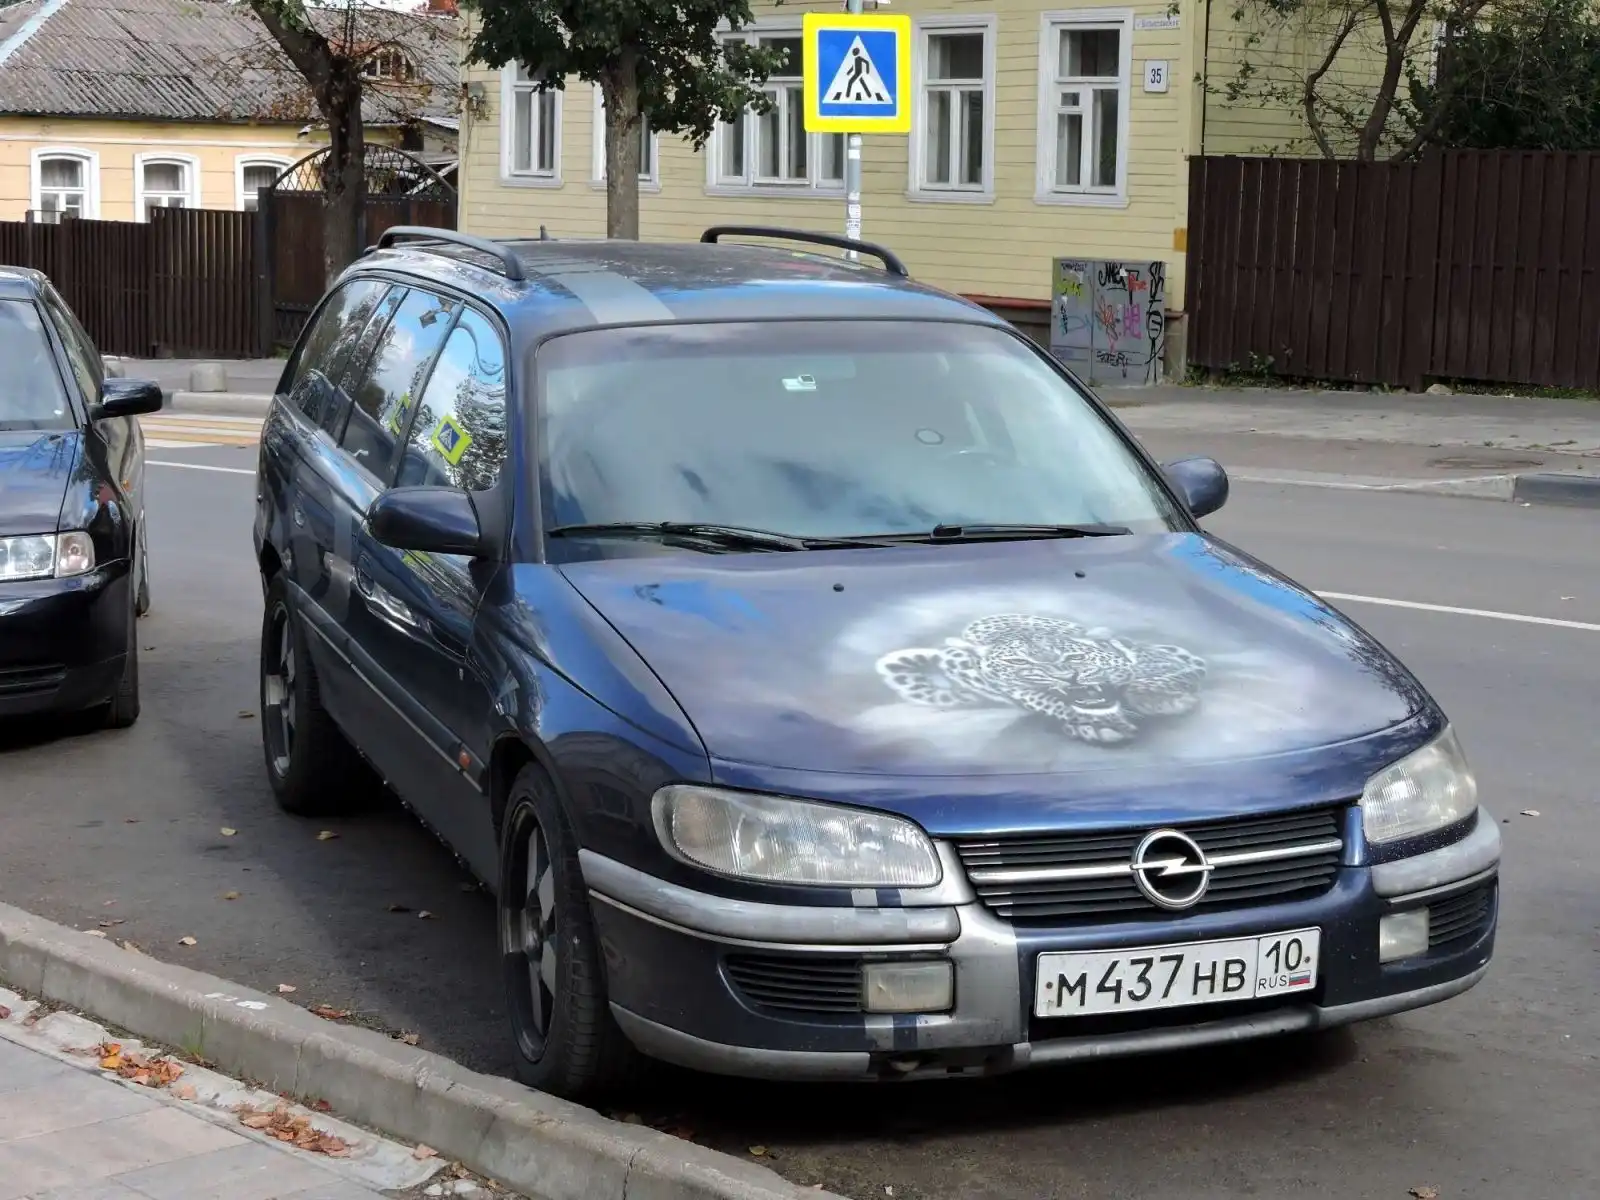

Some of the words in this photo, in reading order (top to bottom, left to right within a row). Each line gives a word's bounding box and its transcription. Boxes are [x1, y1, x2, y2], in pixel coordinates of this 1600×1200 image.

[1150, 68, 1162, 84] 35
[1265, 938, 1303, 973] 10
[1258, 974, 1288, 991] RUS
